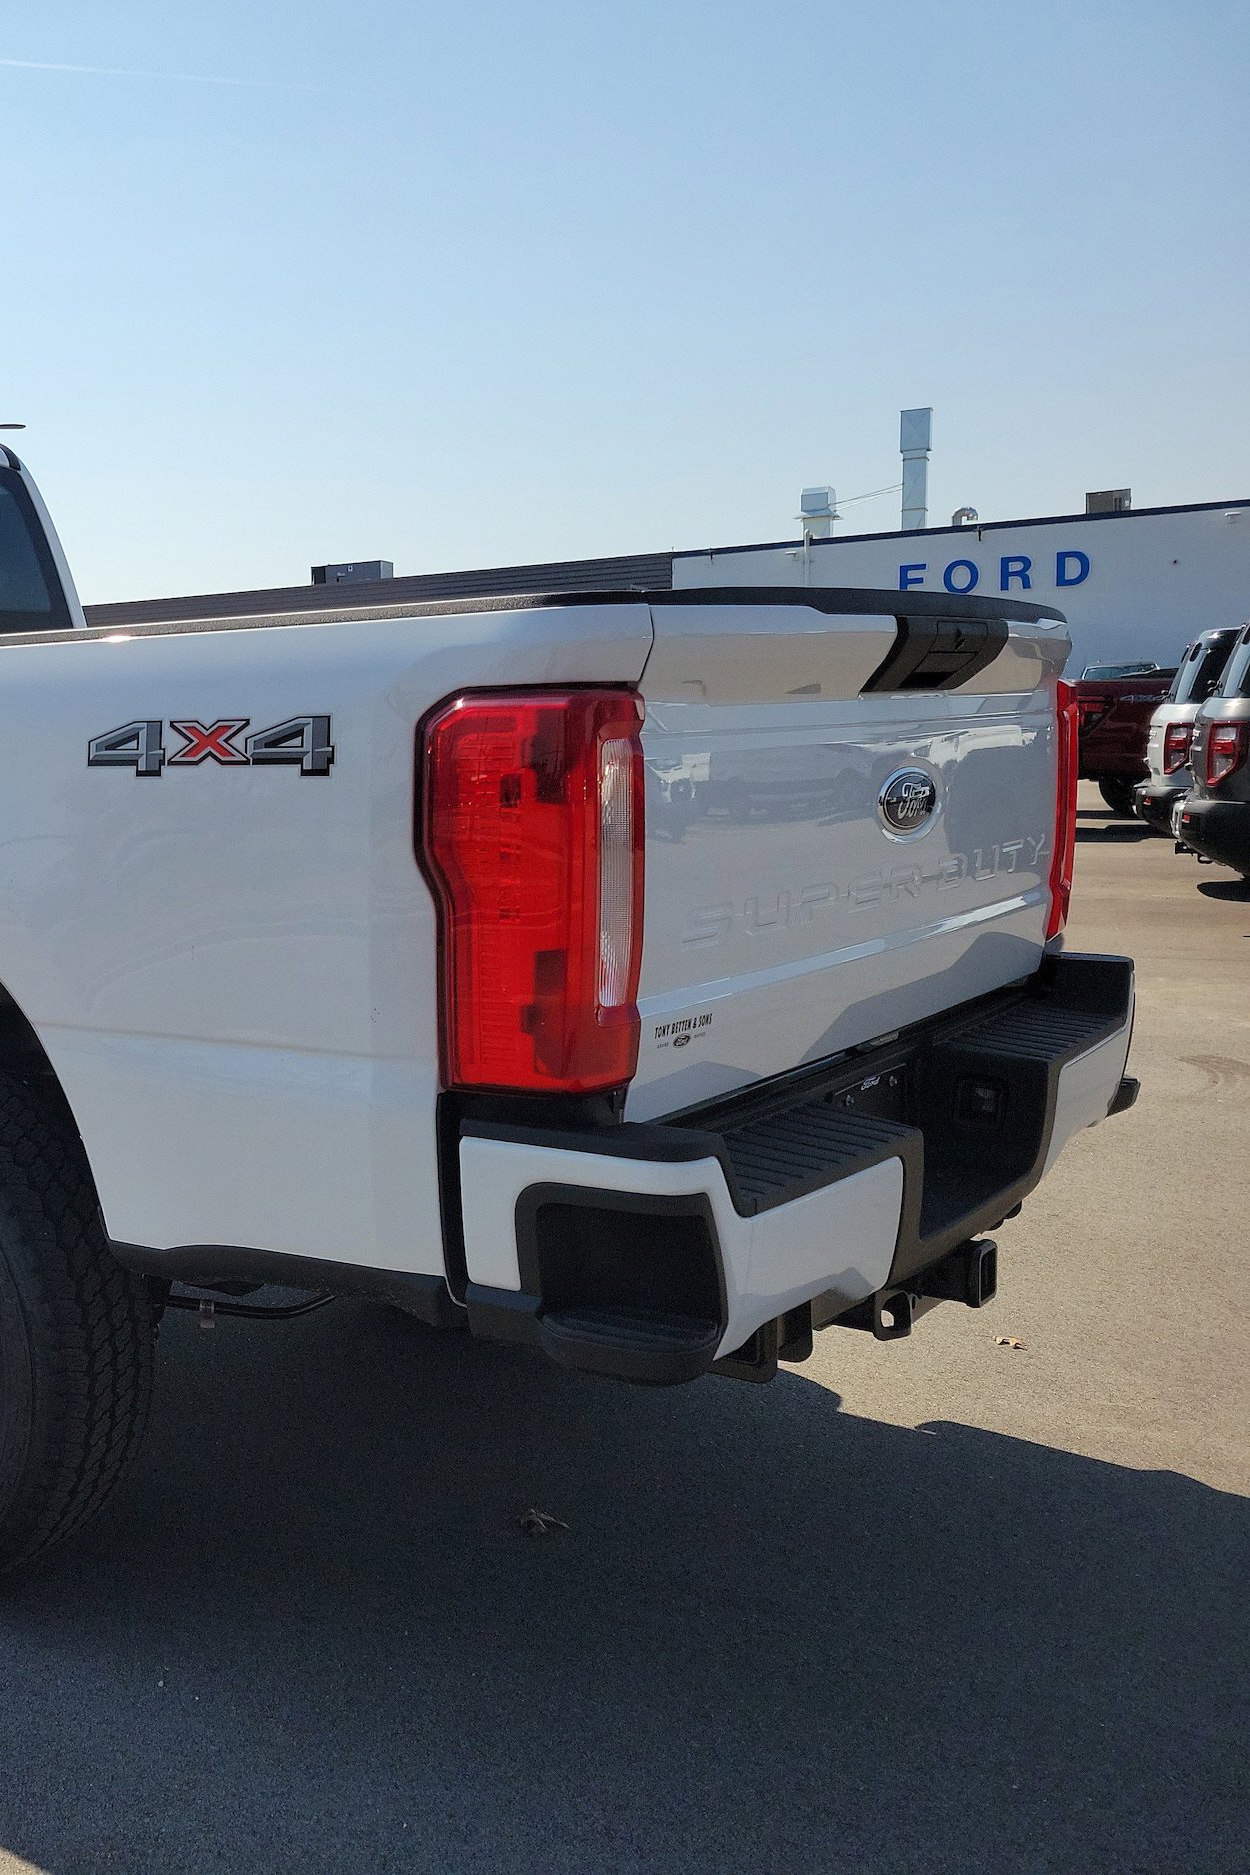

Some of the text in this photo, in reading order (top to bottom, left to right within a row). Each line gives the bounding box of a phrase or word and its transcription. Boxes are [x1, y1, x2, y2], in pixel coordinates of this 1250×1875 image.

[899, 551, 1090, 593] FORD
[680, 833, 1046, 951] SUPER DUTY
[654, 1024, 670, 1039] TONY
